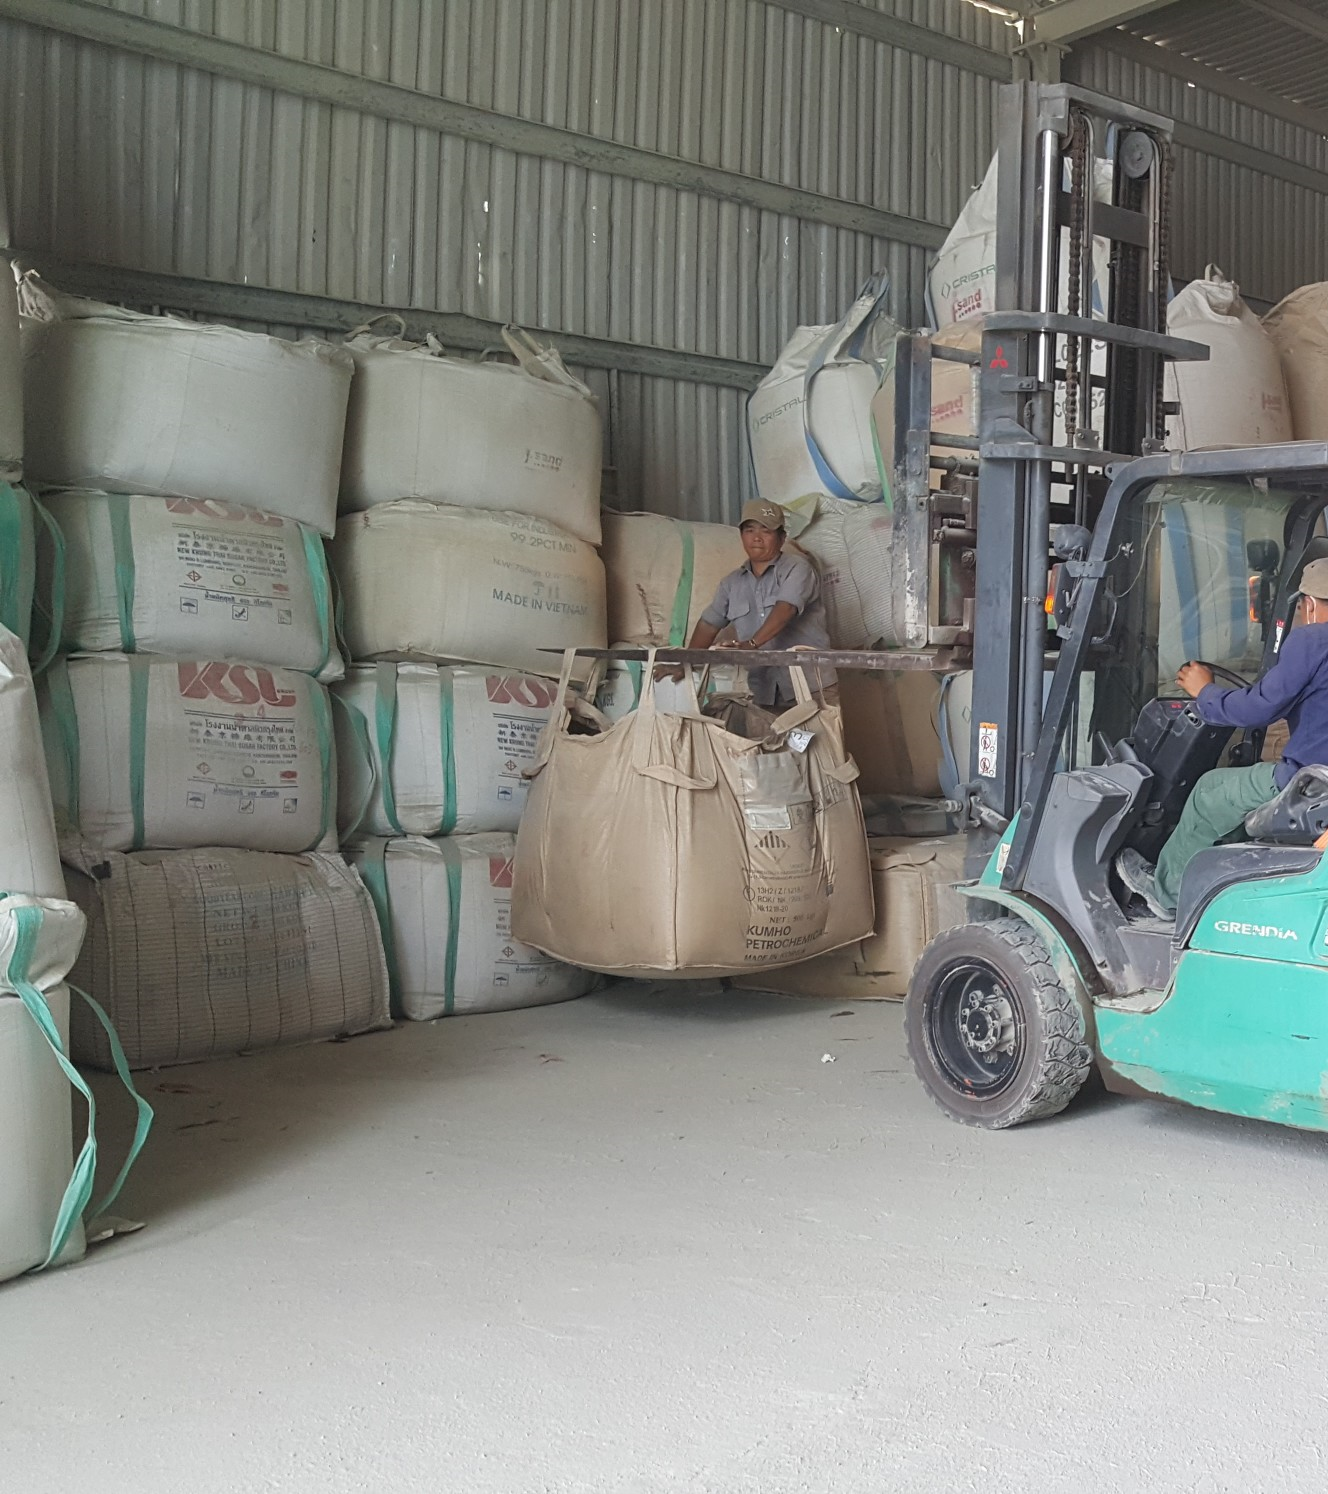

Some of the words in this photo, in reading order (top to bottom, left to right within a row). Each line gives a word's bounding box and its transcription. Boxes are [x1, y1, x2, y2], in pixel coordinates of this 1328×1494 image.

[952, 264, 997, 289] CRISTA
[759, 396, 807, 425] CRISTAL
[492, 588, 528, 608] MADE
[531, 598, 543, 611] IN
[545, 601, 588, 617] VIETNAM
[178, 662, 297, 707] KSL
[746, 925, 792, 937] KUMHO
